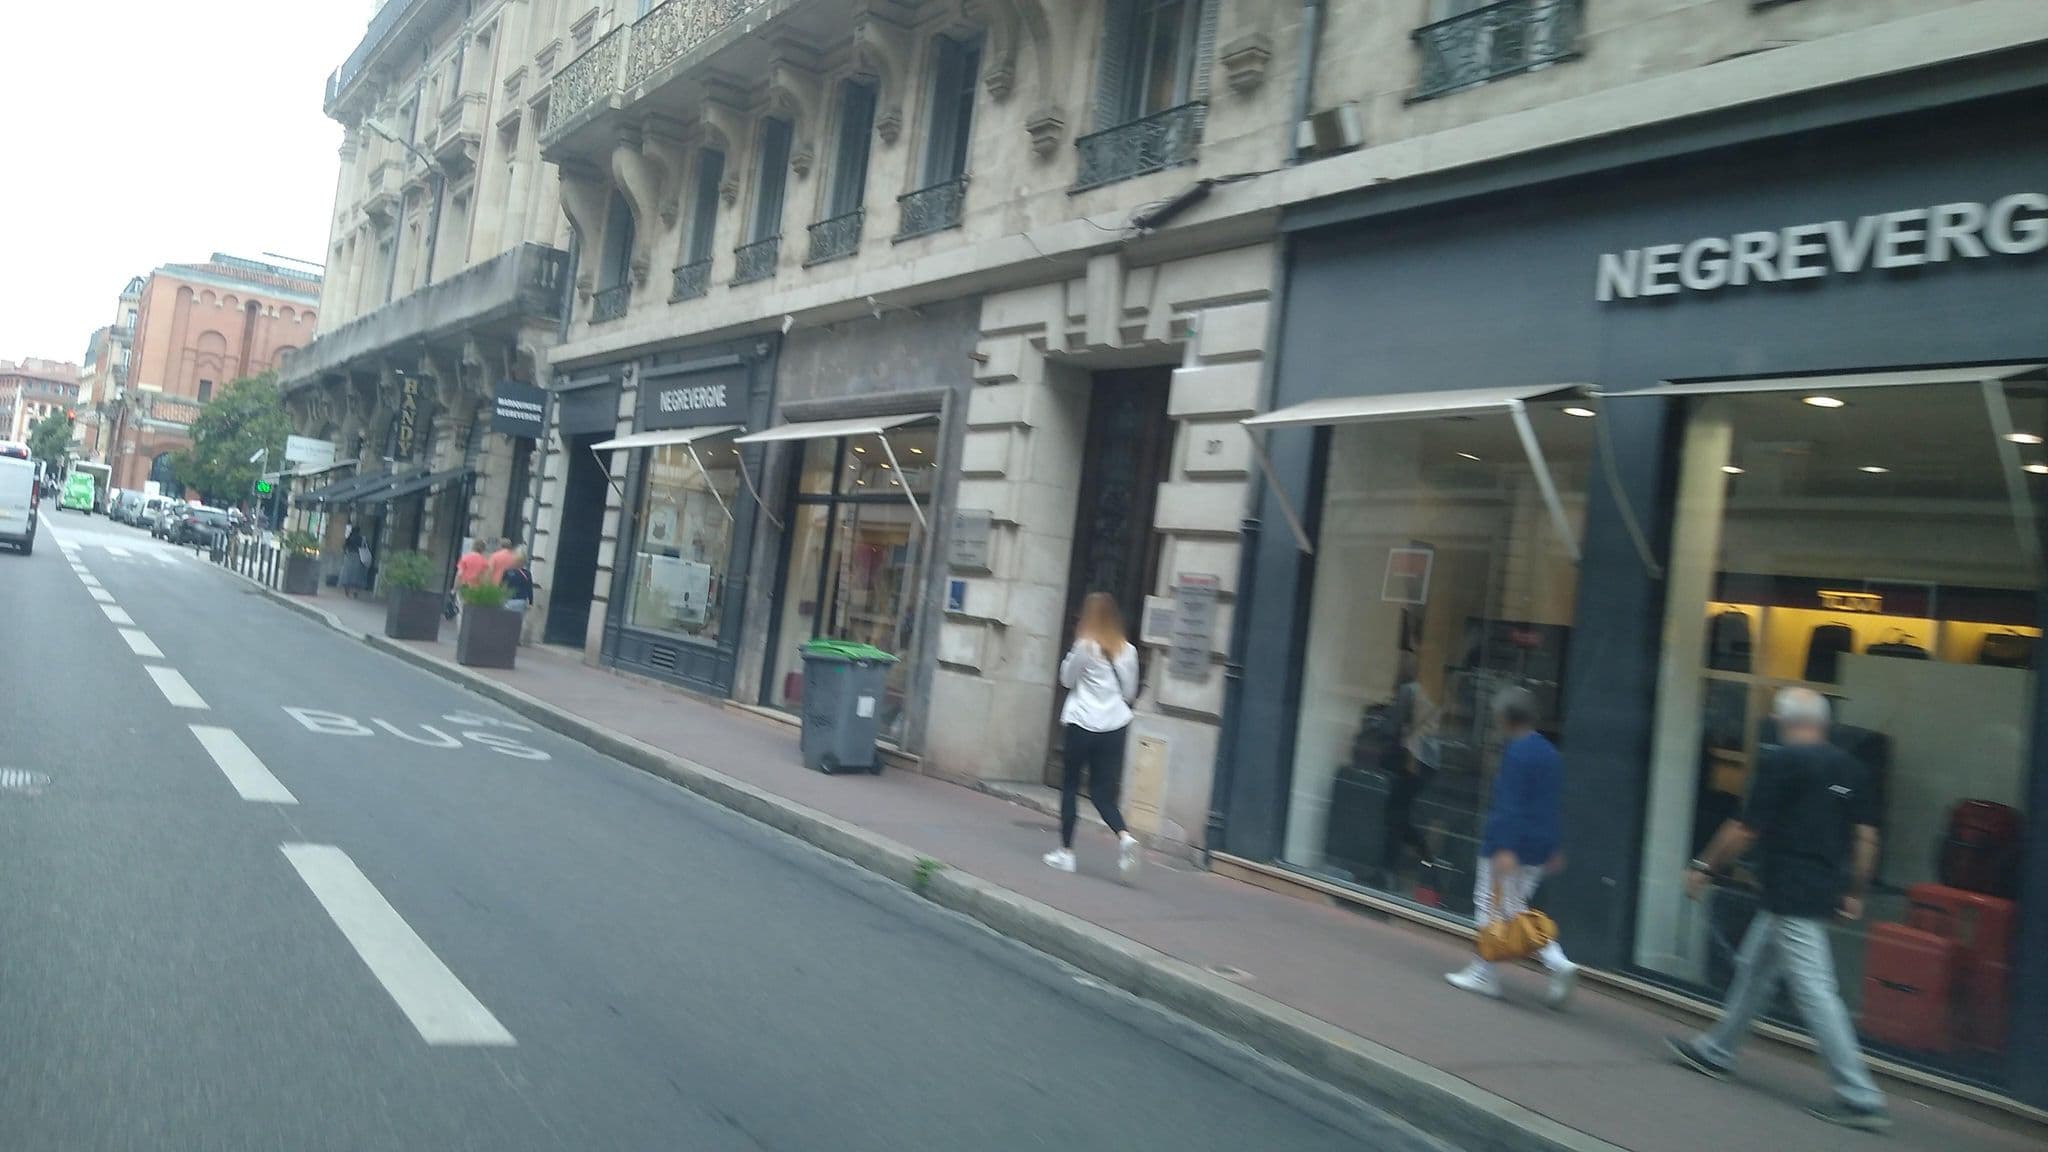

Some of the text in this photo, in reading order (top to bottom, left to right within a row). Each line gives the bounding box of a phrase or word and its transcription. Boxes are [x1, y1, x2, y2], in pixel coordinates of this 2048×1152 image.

[1596, 193, 2048, 301] NEGREVERG
[660, 384, 727, 413] NEGREVERGNE
[281, 705, 552, 761] BUS
